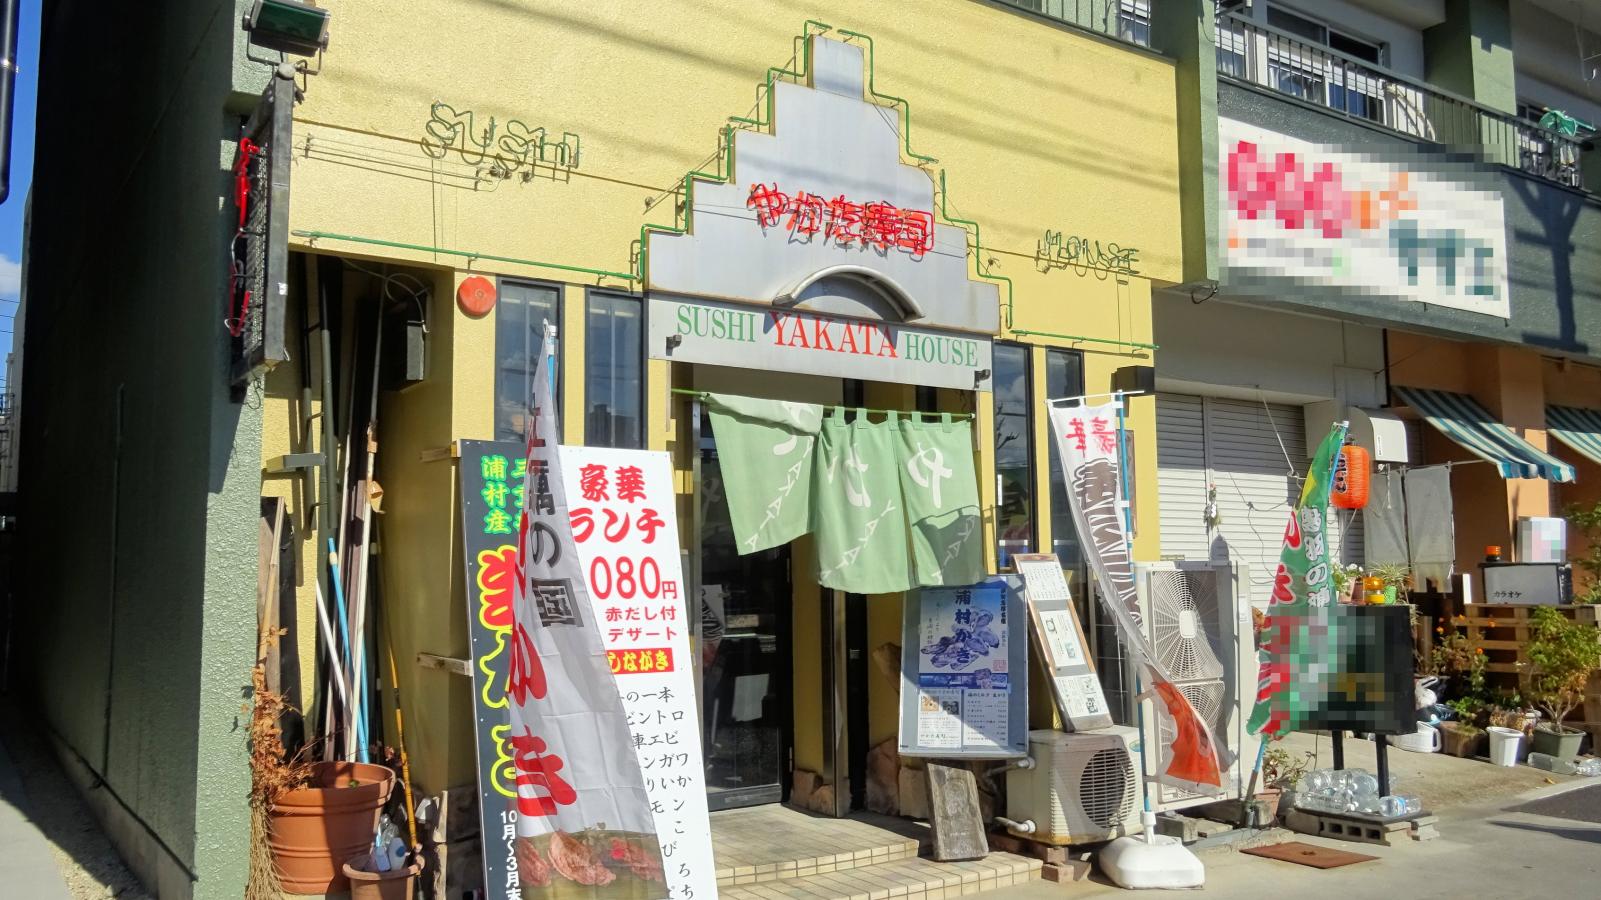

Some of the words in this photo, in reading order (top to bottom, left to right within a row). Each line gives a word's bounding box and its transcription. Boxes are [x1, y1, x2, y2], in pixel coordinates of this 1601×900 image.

[676, 304, 757, 343] SUSHI
[769, 311, 898, 359] YAKATA
[904, 333, 978, 368] HOUSE
[579, 463, 647, 504] 豪華
[481, 455, 512, 534] 浦村産
[569, 507, 666, 544] ランチ
[1493, 590, 1522, 598] カラオケ
[605, 605, 677, 622] 赤だし付
[608, 626, 678, 643] デザート
[620, 686, 675, 703] の一本
[632, 731, 680, 750] 車エビ
[643, 753, 689, 769] ンガワ
[646, 775, 693, 792] りいか
